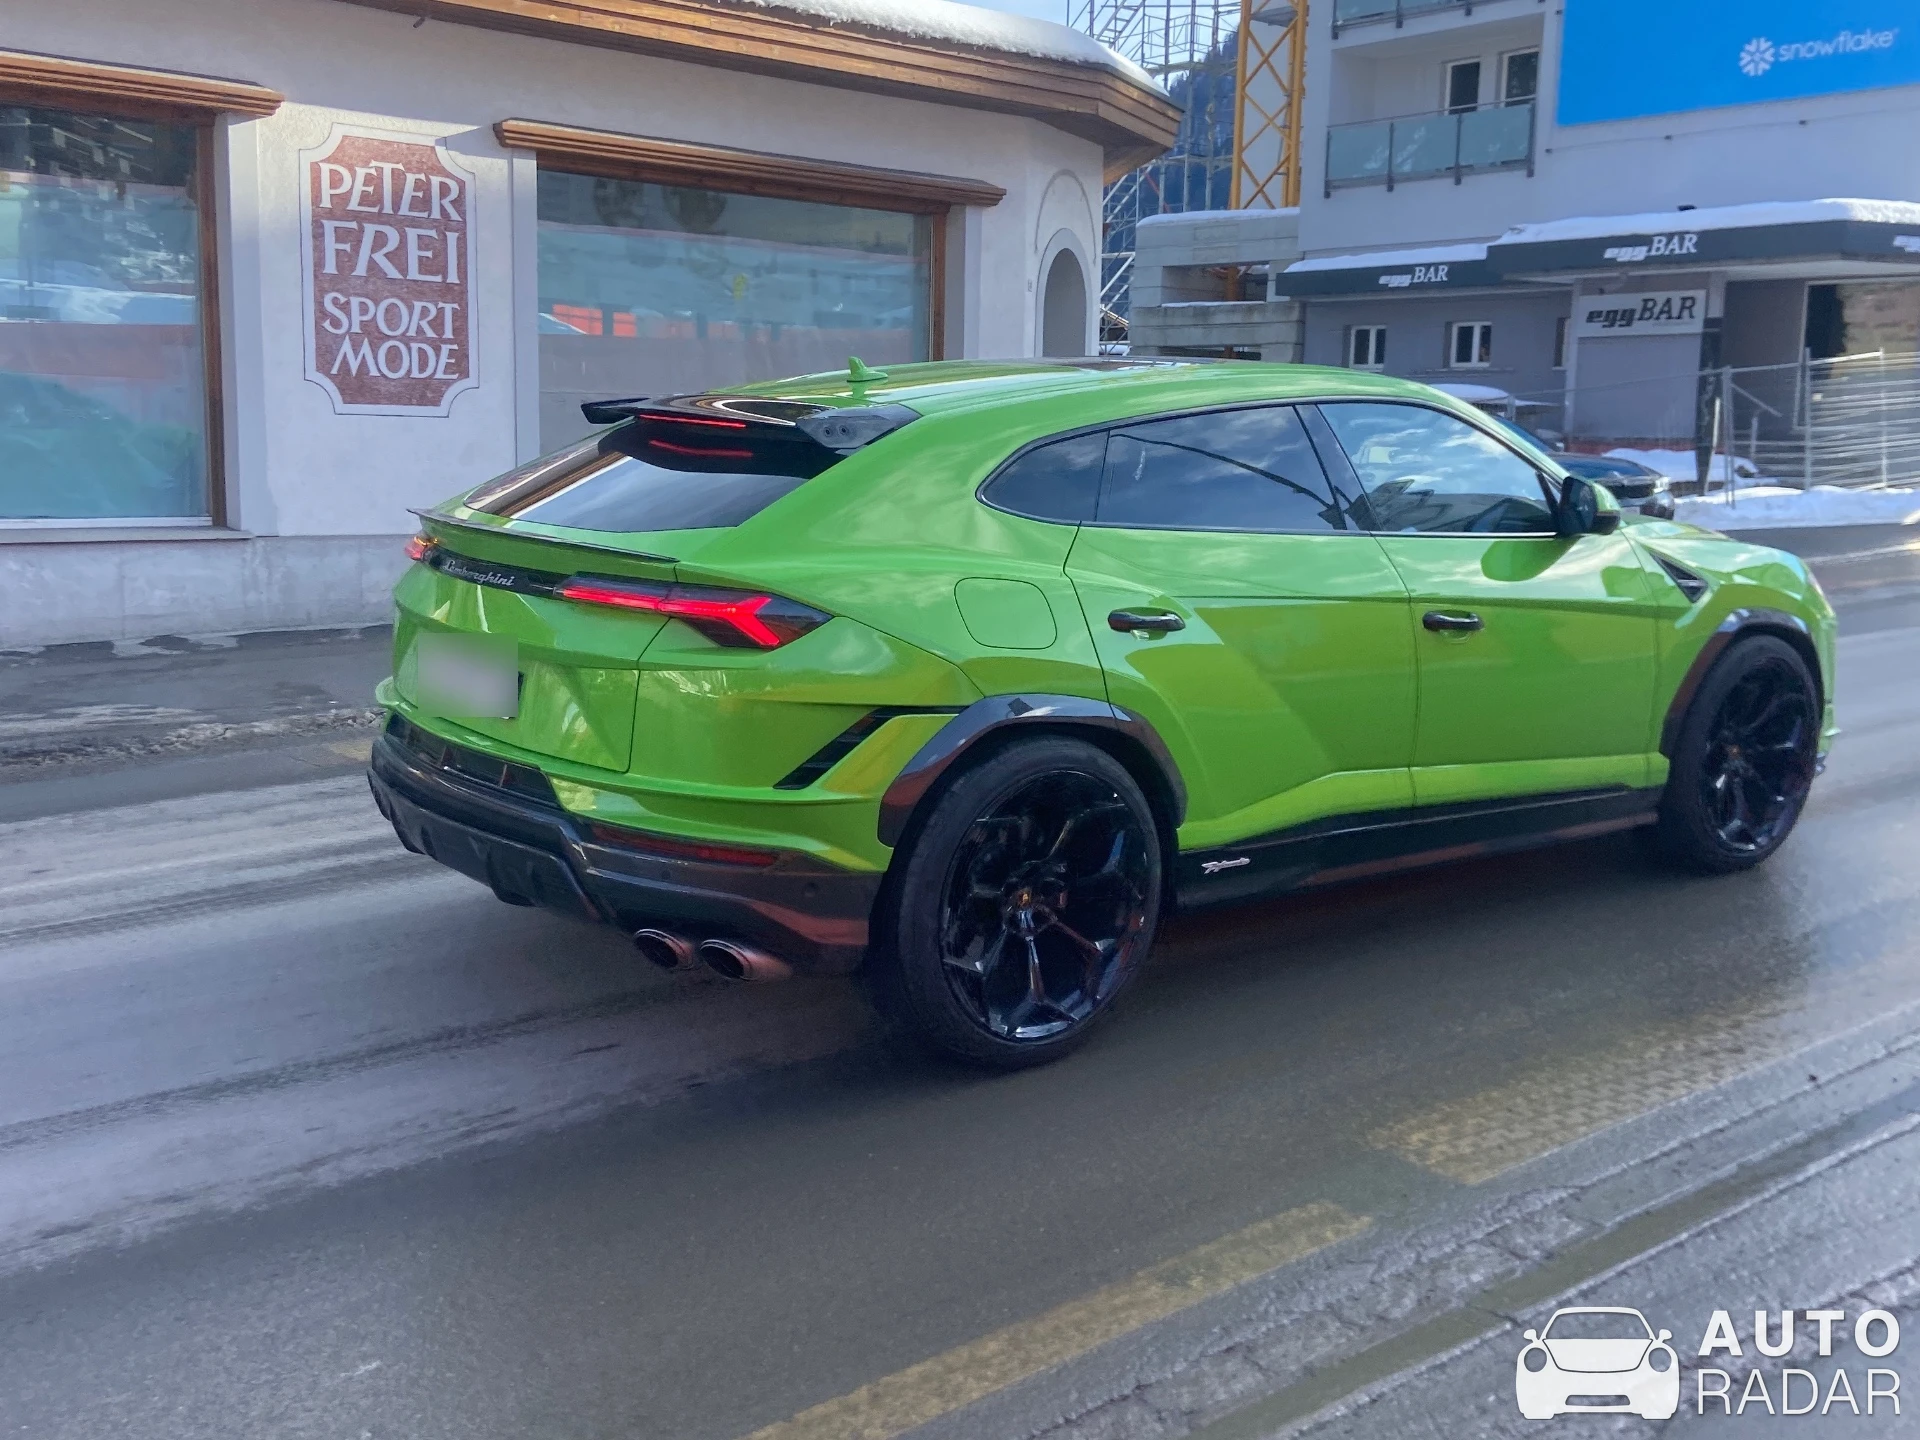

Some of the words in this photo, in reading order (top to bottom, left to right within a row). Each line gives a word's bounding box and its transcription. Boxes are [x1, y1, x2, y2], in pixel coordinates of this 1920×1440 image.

[1778, 28, 1895, 62] snowflake
[318, 160, 463, 221] PETER
[321, 219, 460, 283] FREI
[321, 291, 460, 339] SPORT
[330, 334, 459, 380] MODE
